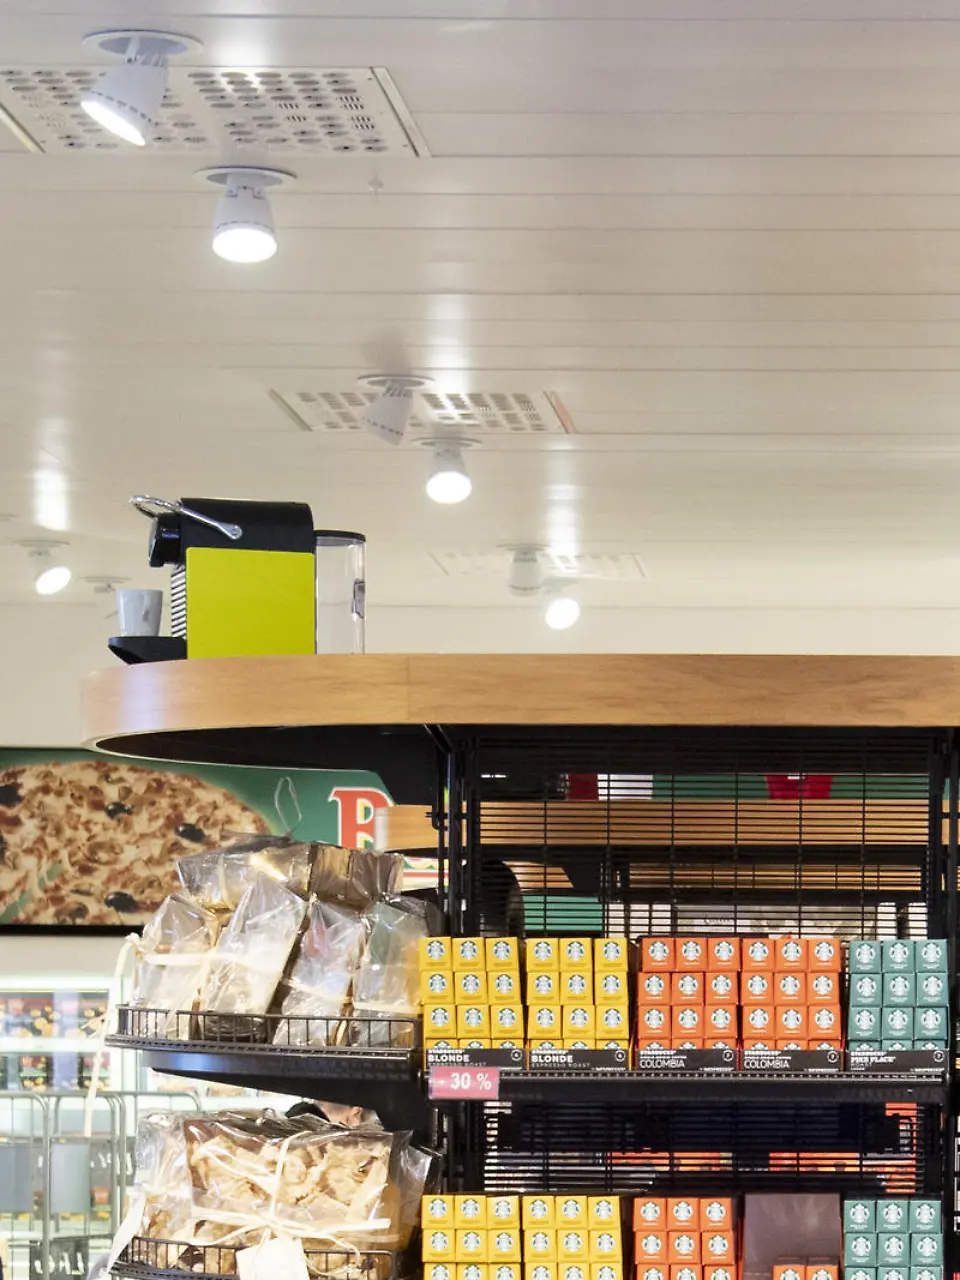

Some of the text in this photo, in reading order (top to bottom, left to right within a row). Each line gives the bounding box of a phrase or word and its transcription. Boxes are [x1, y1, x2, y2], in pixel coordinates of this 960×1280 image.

[428, 1054, 470, 1063] BLONDE
[532, 1055, 573, 1063] BLONDE
[640, 1059, 685, 1069] COLOMBIA
[744, 1060, 790, 1070] COLOMBIA
[476, 1073, 492, 1091] %
